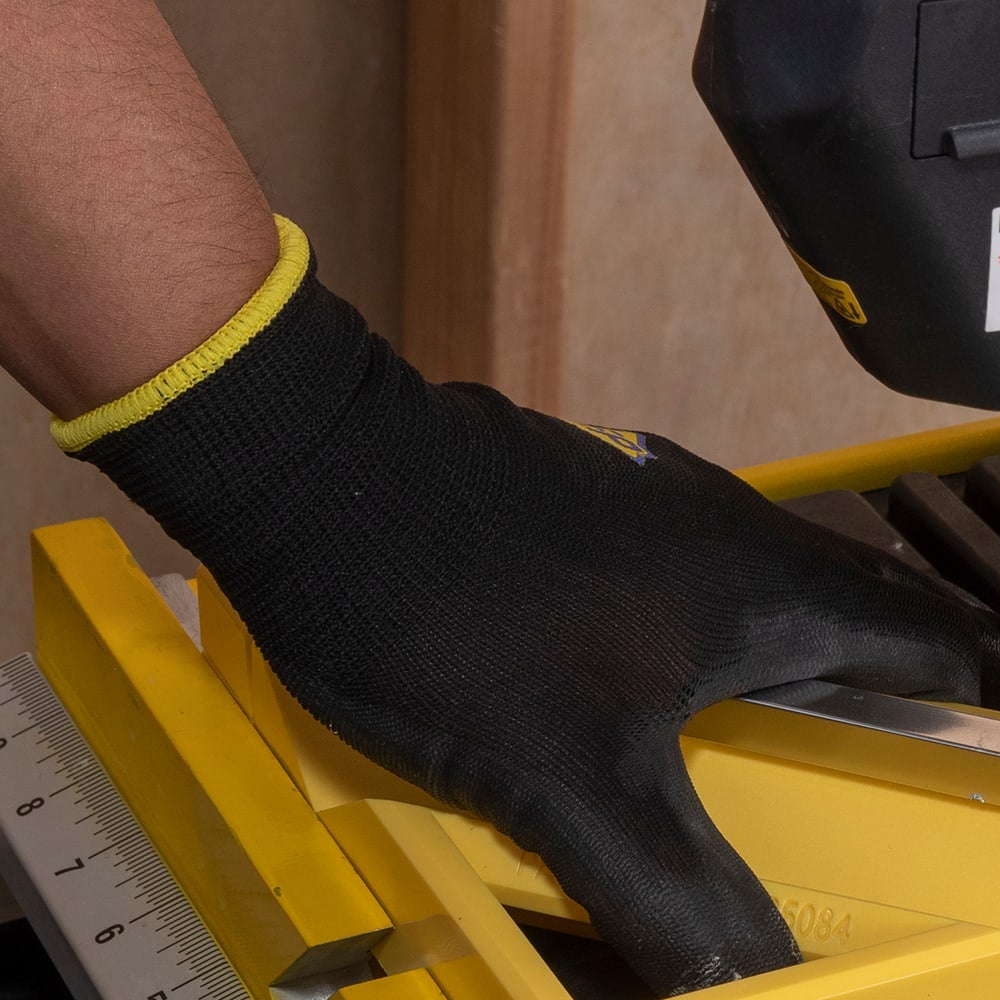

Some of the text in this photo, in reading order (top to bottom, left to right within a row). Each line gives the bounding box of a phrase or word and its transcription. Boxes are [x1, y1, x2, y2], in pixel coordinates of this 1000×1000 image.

[16, 797, 45, 817] 8
[54, 857, 85, 877] 7
[95, 923, 124, 945] 6
[773, 896, 851, 941] 5084
